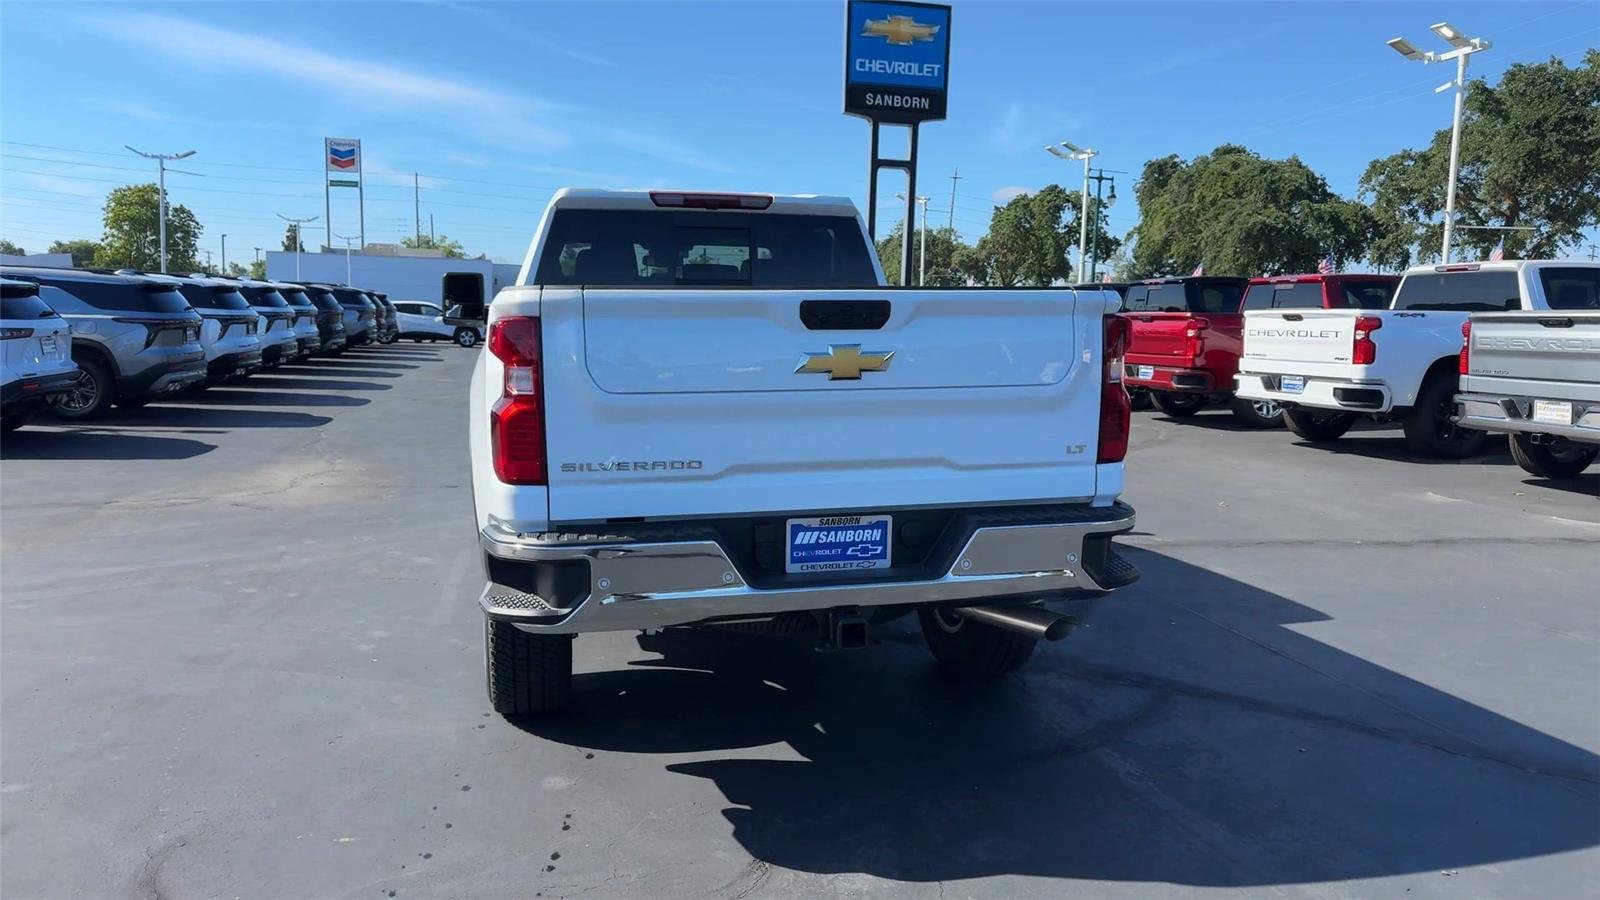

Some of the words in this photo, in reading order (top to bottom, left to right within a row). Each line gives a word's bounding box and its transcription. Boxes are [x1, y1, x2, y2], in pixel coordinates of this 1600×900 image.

[855, 58, 941, 77] CHEVROLET
[865, 93, 929, 110] SANBORN
[1248, 329, 1342, 339] CHEVROLET
[1066, 444, 1087, 455] LT
[560, 460, 702, 472] SILVERADO
[818, 517, 861, 526] SANBORN
[818, 529, 881, 543] SANBORN
[793, 548, 842, 558] CHEVROLET
[800, 561, 853, 571] CHEVROLET
